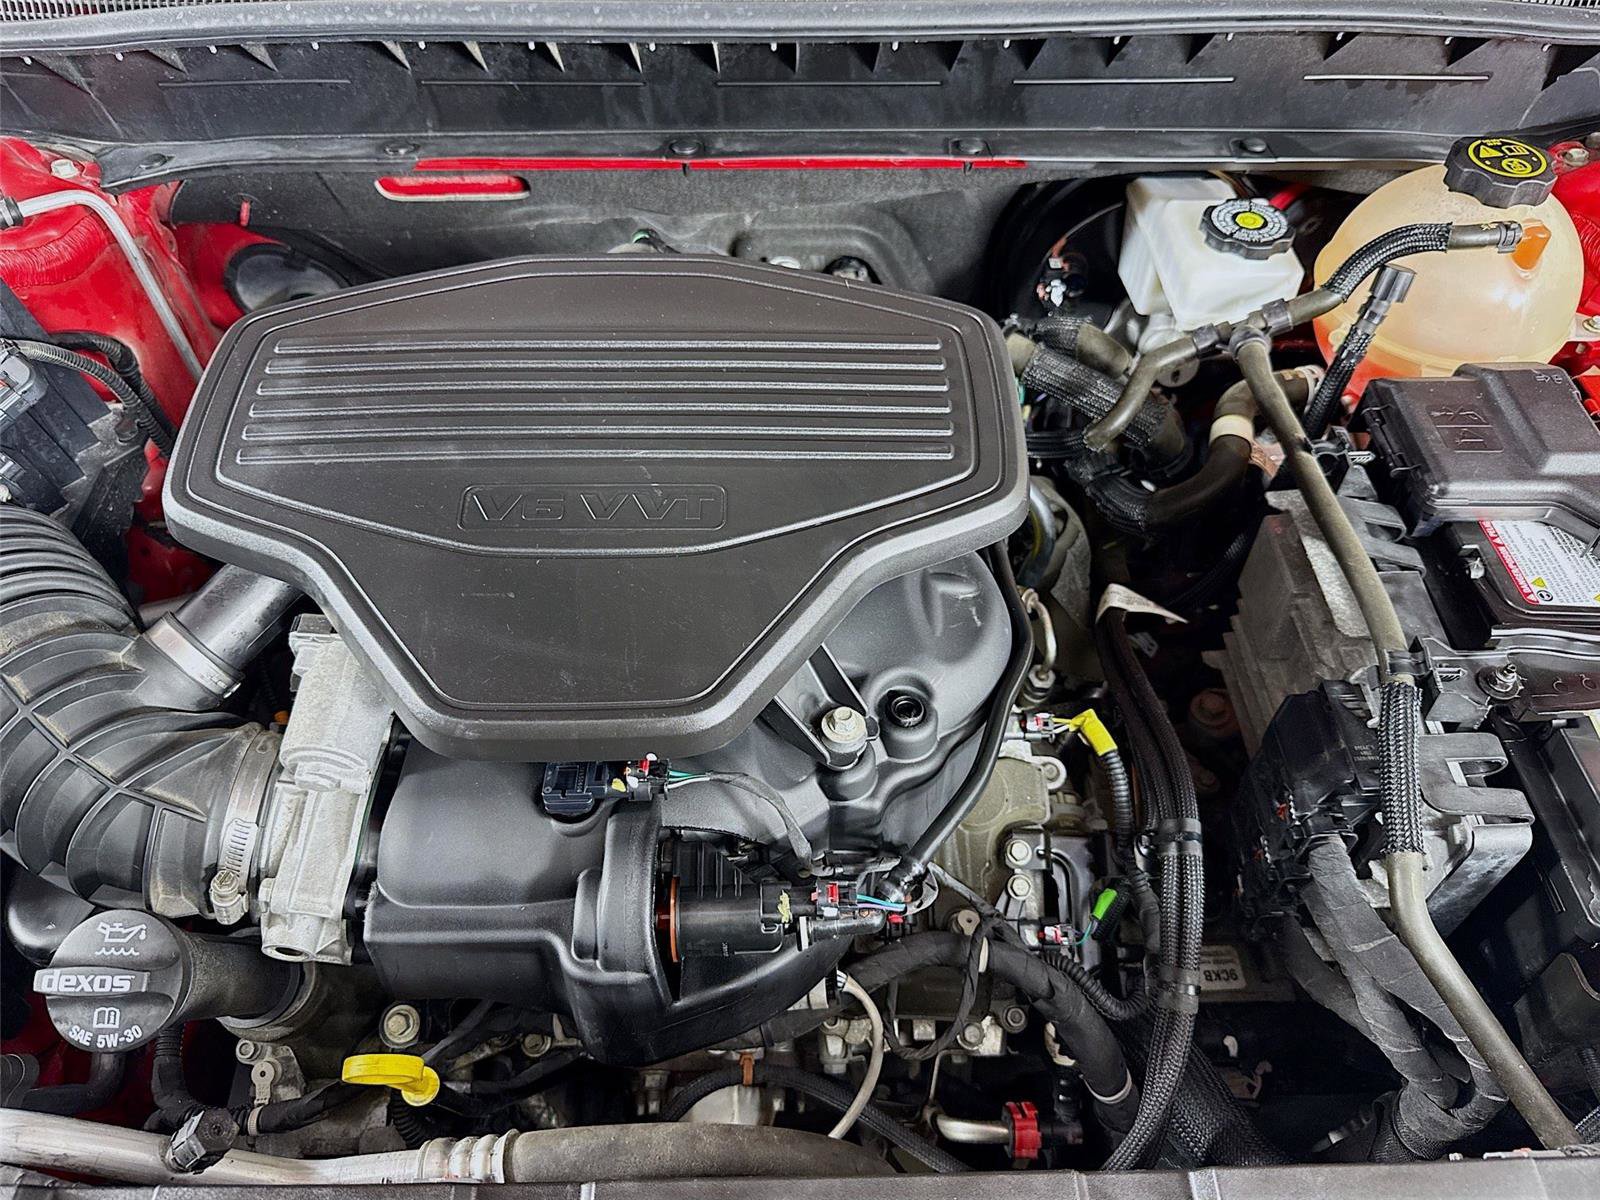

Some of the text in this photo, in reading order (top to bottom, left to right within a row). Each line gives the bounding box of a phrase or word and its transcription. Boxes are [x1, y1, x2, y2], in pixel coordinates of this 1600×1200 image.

[473, 493, 715, 520] V6 VVT
[41, 969, 132, 992] dexos
[68, 1024, 143, 1048] SAE 5W-30
